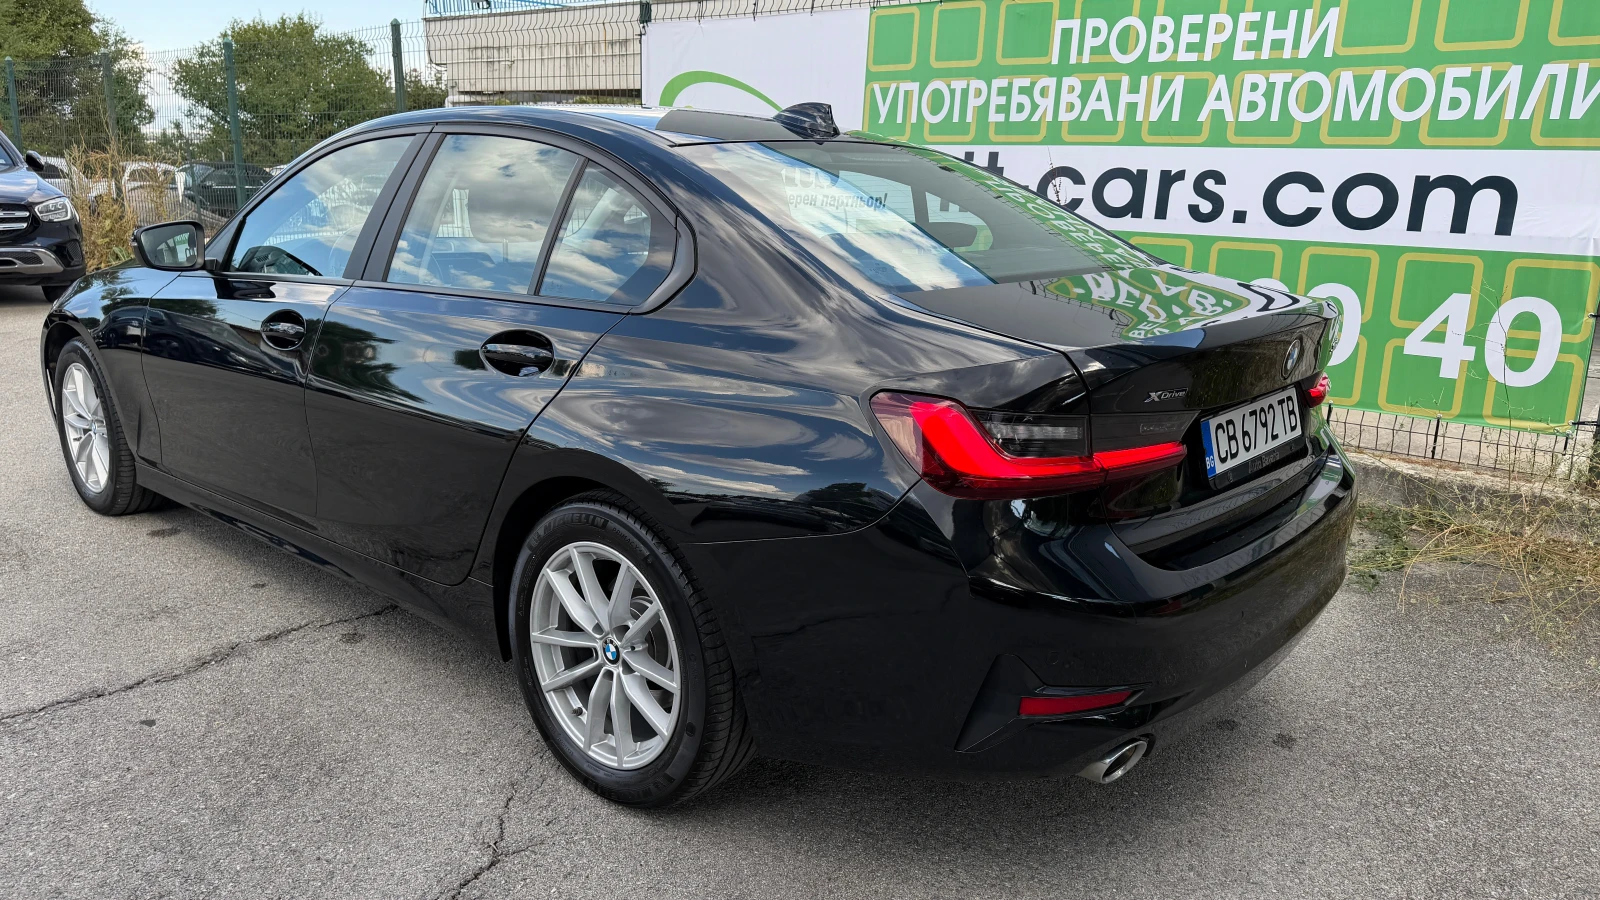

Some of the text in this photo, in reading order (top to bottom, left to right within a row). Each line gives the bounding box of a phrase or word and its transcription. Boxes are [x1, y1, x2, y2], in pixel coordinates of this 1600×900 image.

[1051, 6, 1340, 65] ПРОВЕРЕНИ
[872, 75, 1185, 124] УПОТРЕБЯВАНИ
[964, 151, 1519, 238] cars.com
[1403, 292, 1563, 388] 40
